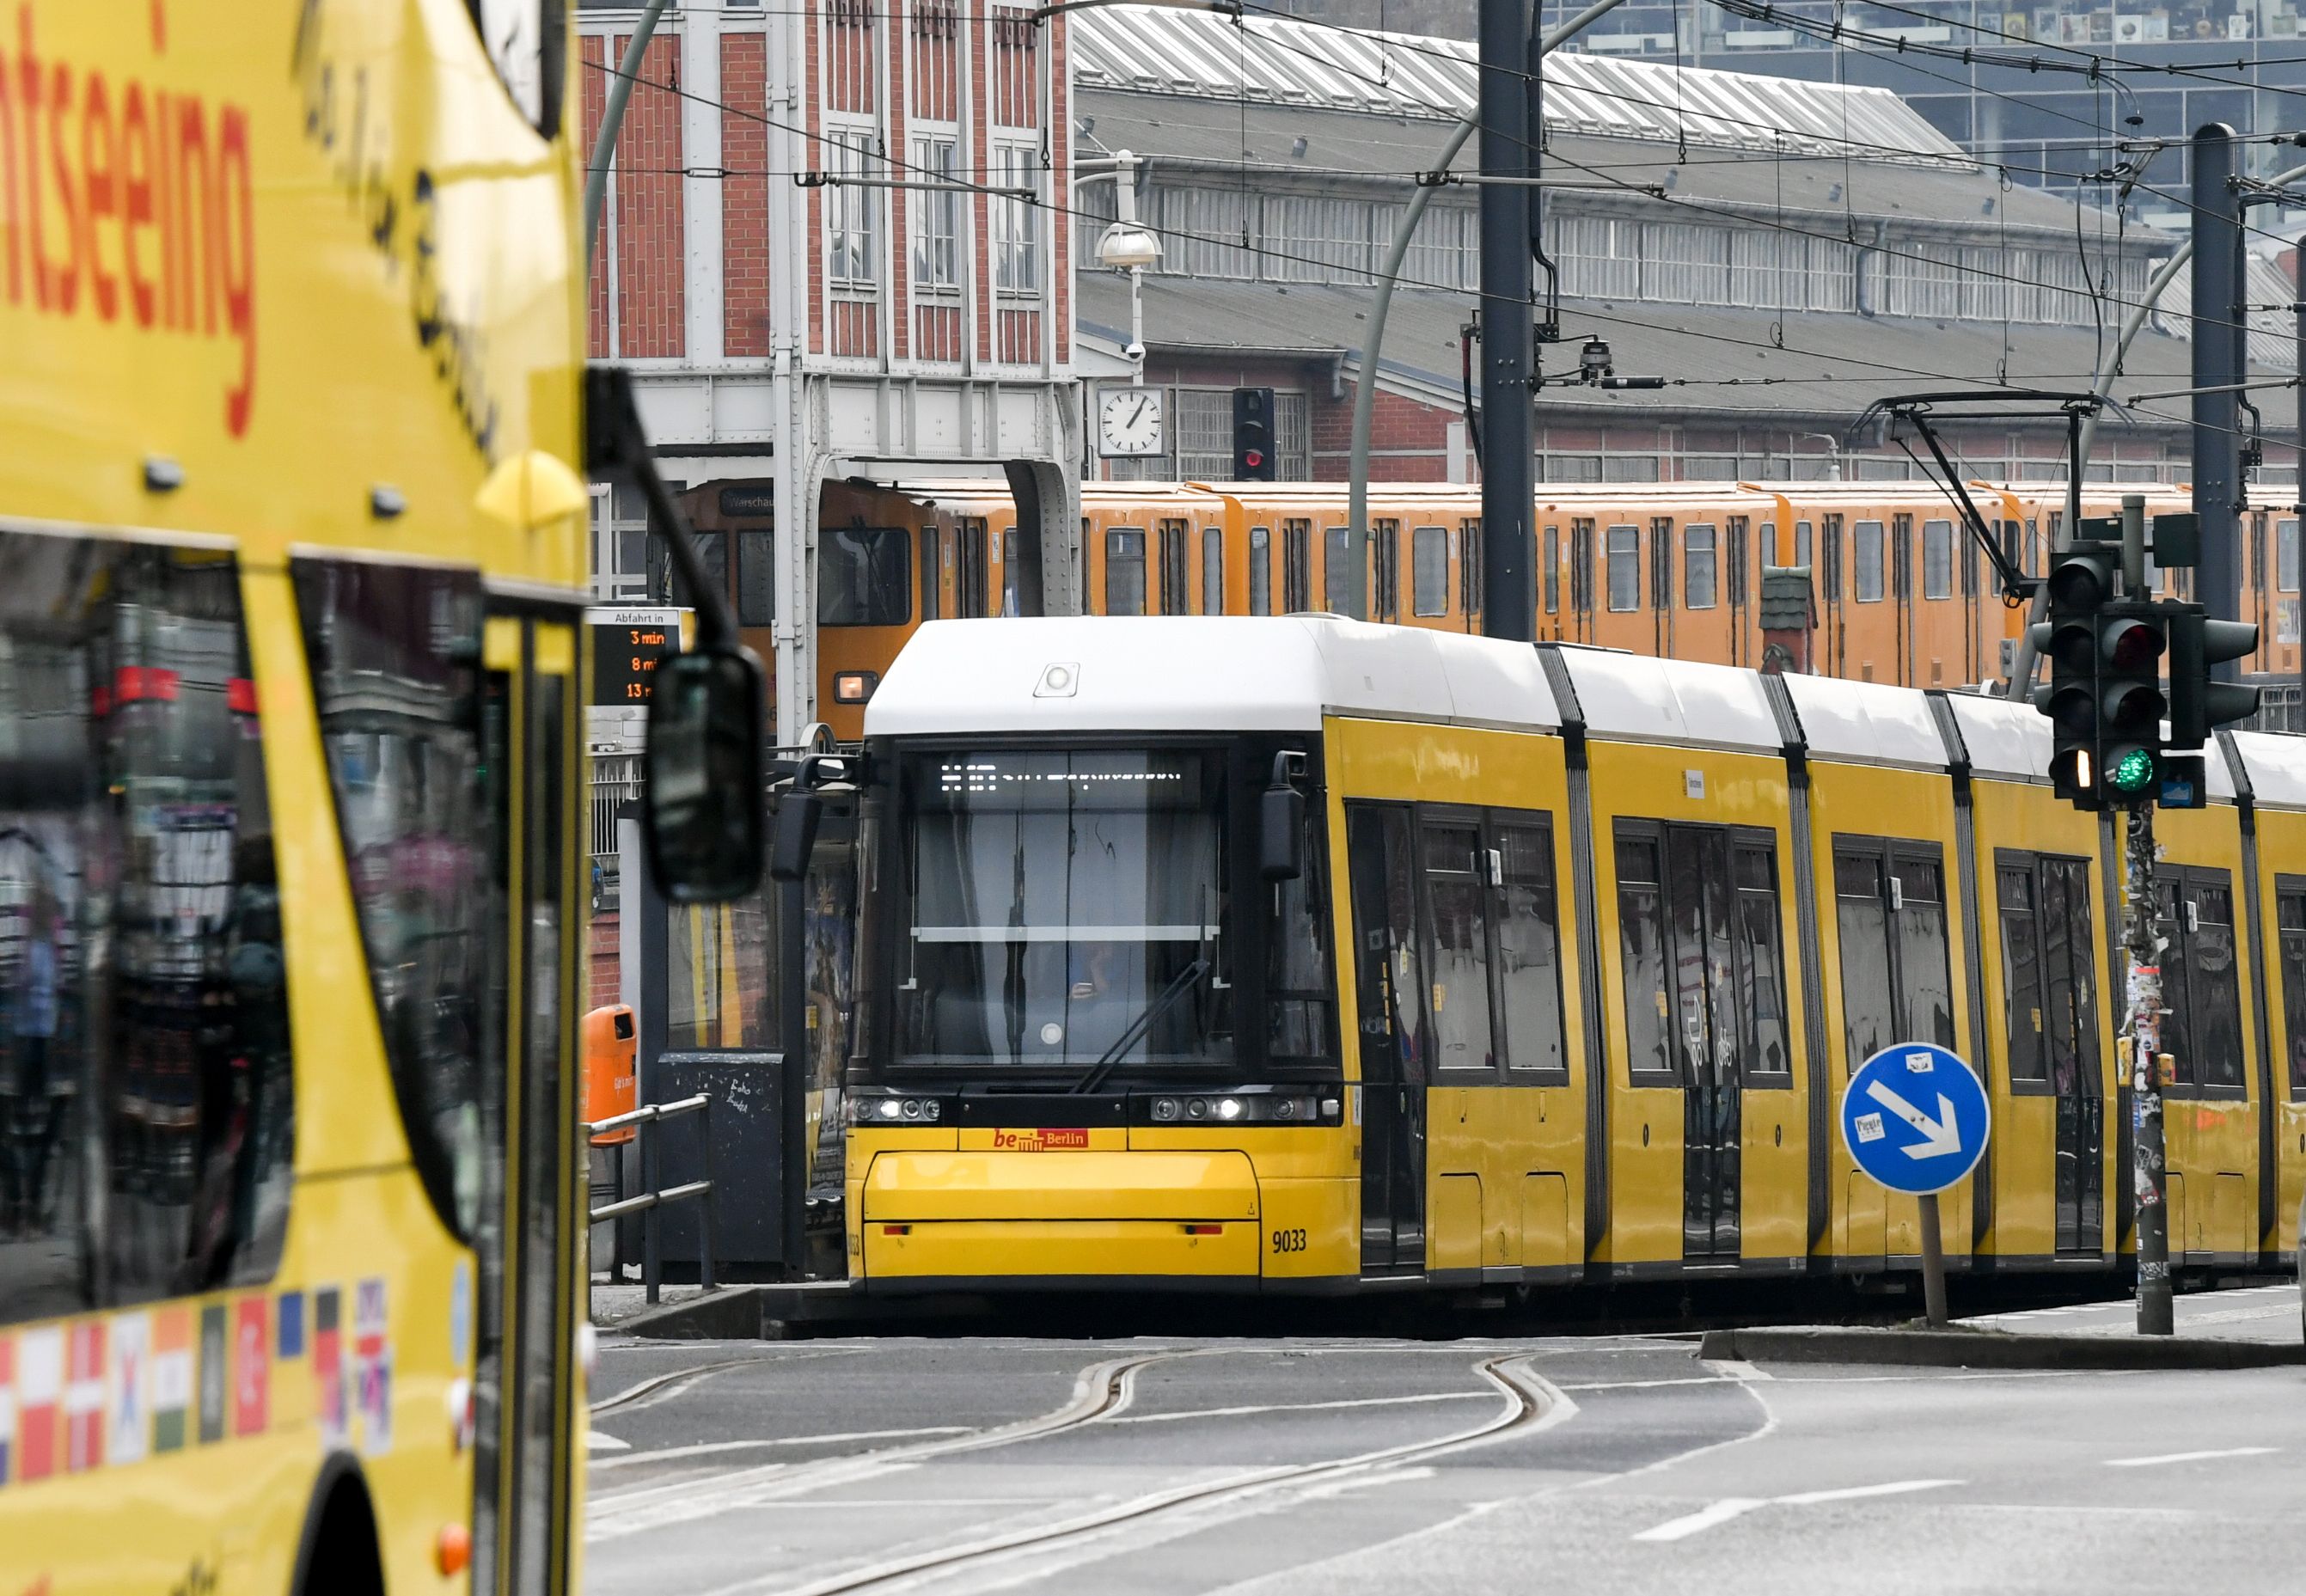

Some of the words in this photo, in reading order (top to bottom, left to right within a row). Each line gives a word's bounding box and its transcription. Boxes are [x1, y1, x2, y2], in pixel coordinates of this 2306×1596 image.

[615, 613, 651, 623] Abfahrt
[654, 613, 664, 623] in
[630, 631, 639, 645] 3
[641, 632, 665, 645] min
[632, 657, 640, 671] 8
[627, 683, 642, 697] 13
[994, 1128, 1018, 1147] be
[1046, 1132, 1085, 1145] Berlin
[1272, 1228, 1306, 1254] 9033
